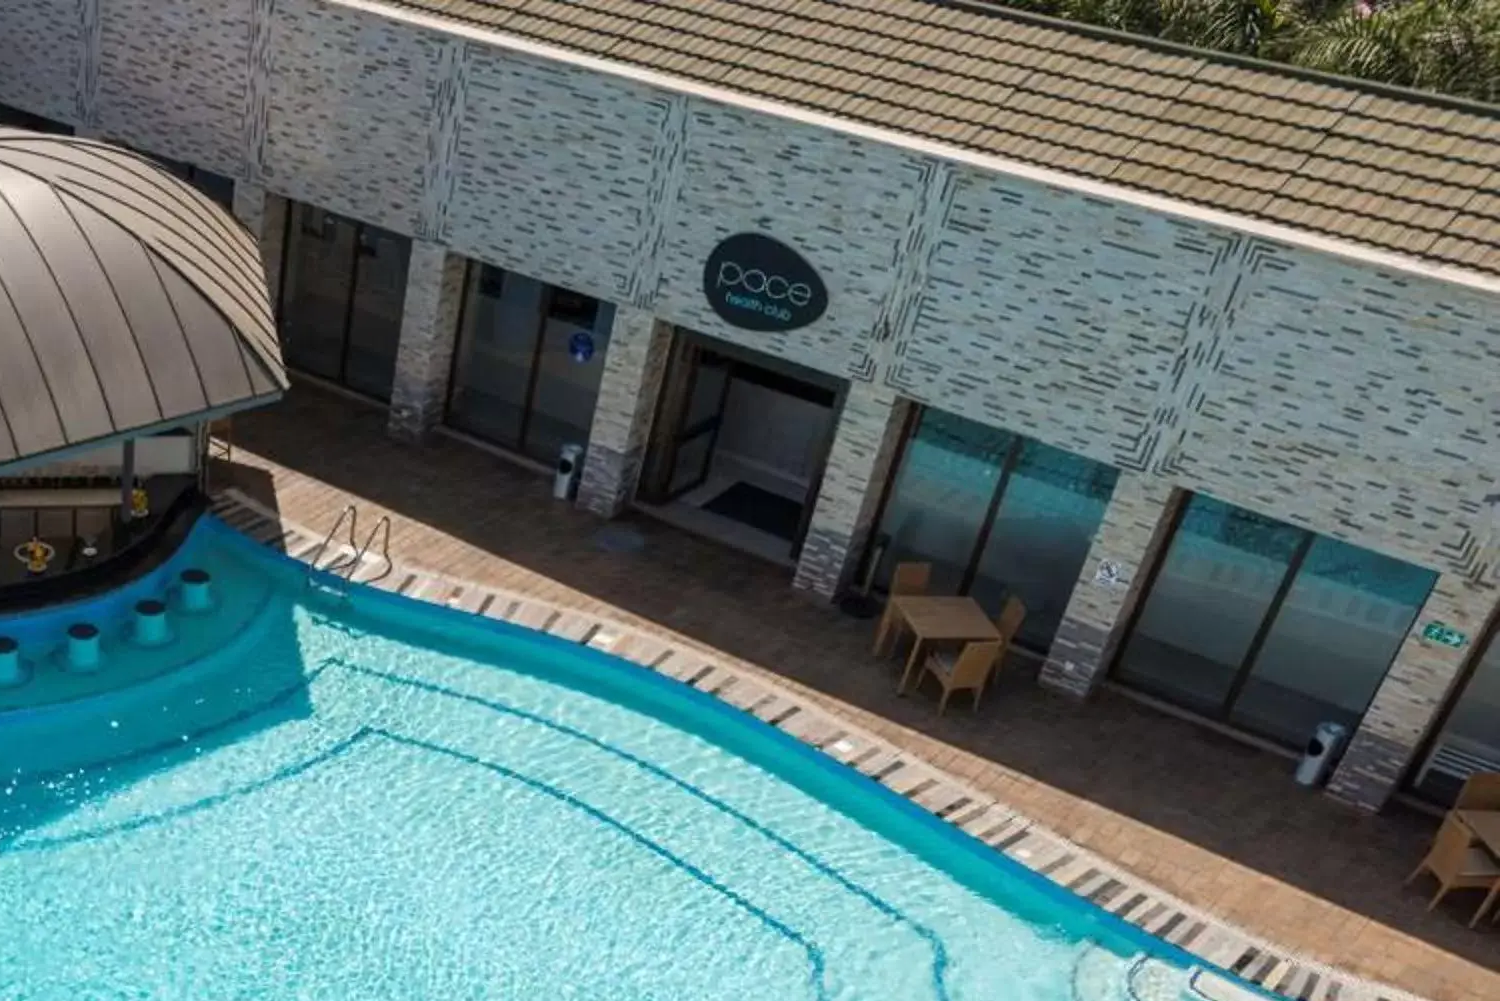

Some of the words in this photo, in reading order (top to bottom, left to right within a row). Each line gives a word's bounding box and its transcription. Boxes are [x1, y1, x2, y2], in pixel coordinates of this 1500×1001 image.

[716, 261, 812, 307] pace
[725, 290, 763, 312] health
[763, 303, 792, 322] club
